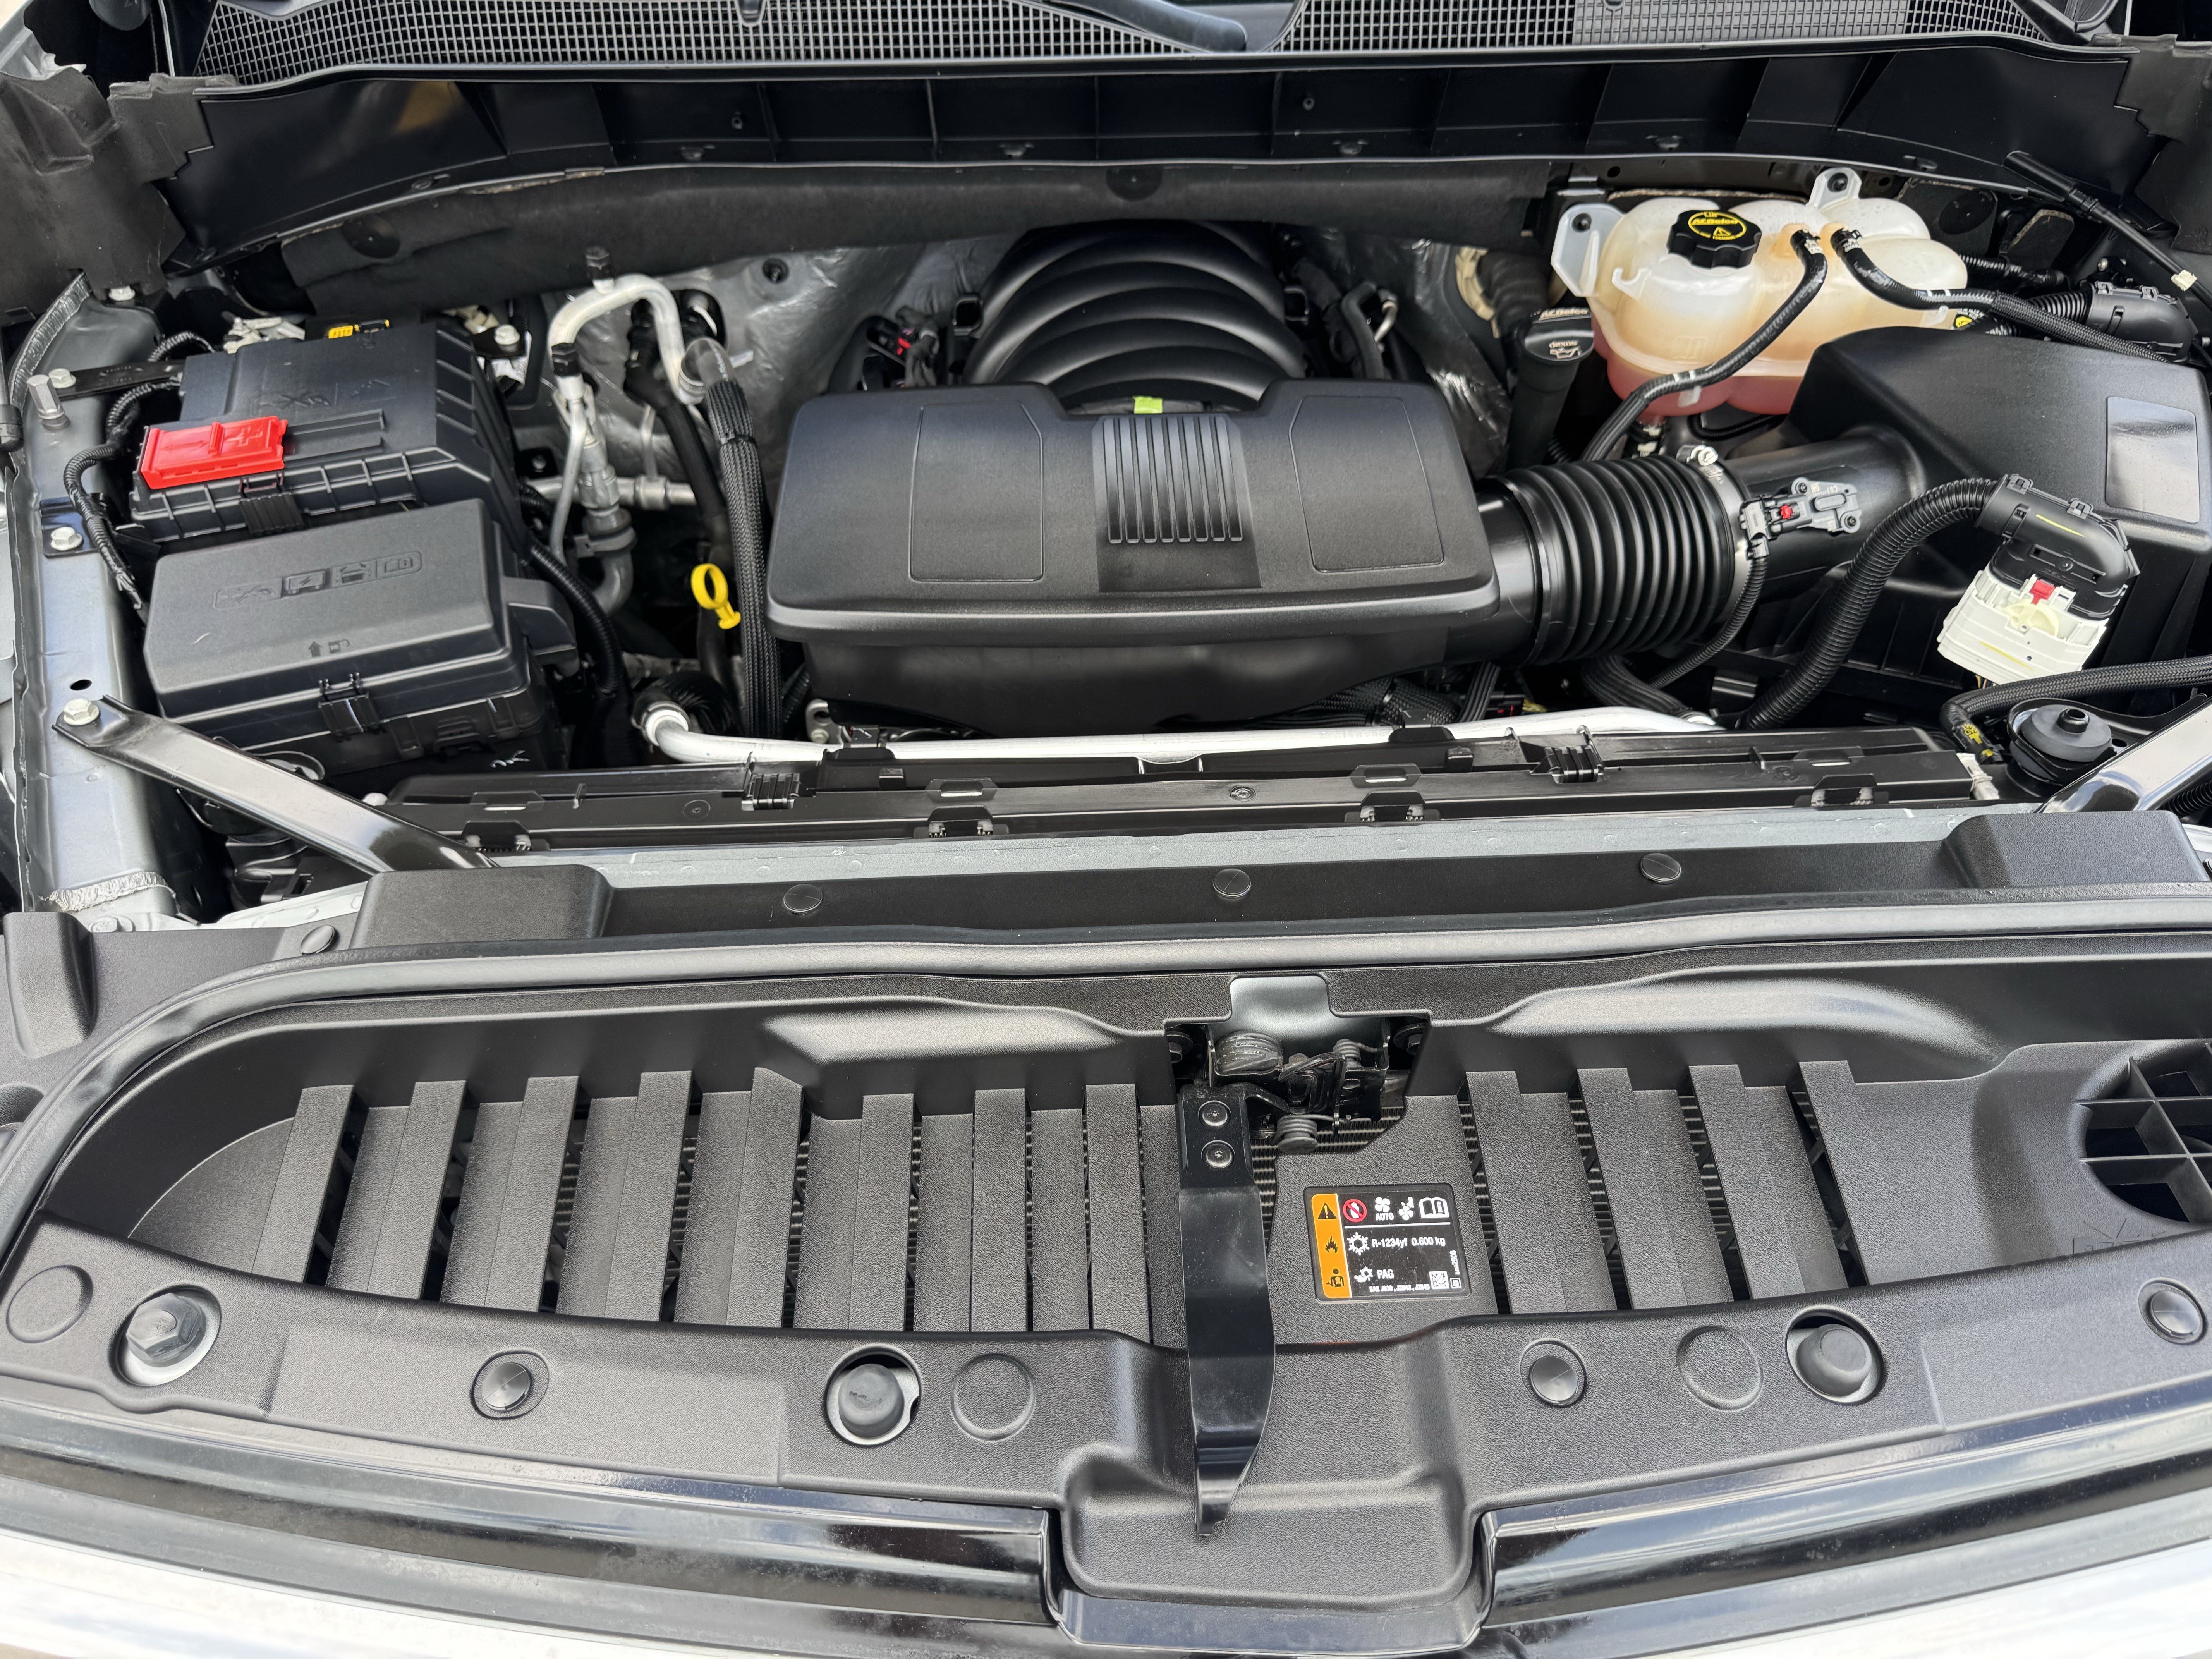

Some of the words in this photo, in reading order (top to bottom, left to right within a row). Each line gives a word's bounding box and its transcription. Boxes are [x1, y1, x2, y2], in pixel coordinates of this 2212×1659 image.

[1376, 1212, 1394, 1221] AUTO
[1371, 1237, 1407, 1248] R-1234yf
[1411, 1237, 1434, 1246] 0.600
[1434, 1236, 1446, 1247] kg
[1377, 1269, 1395, 1279] PAG
